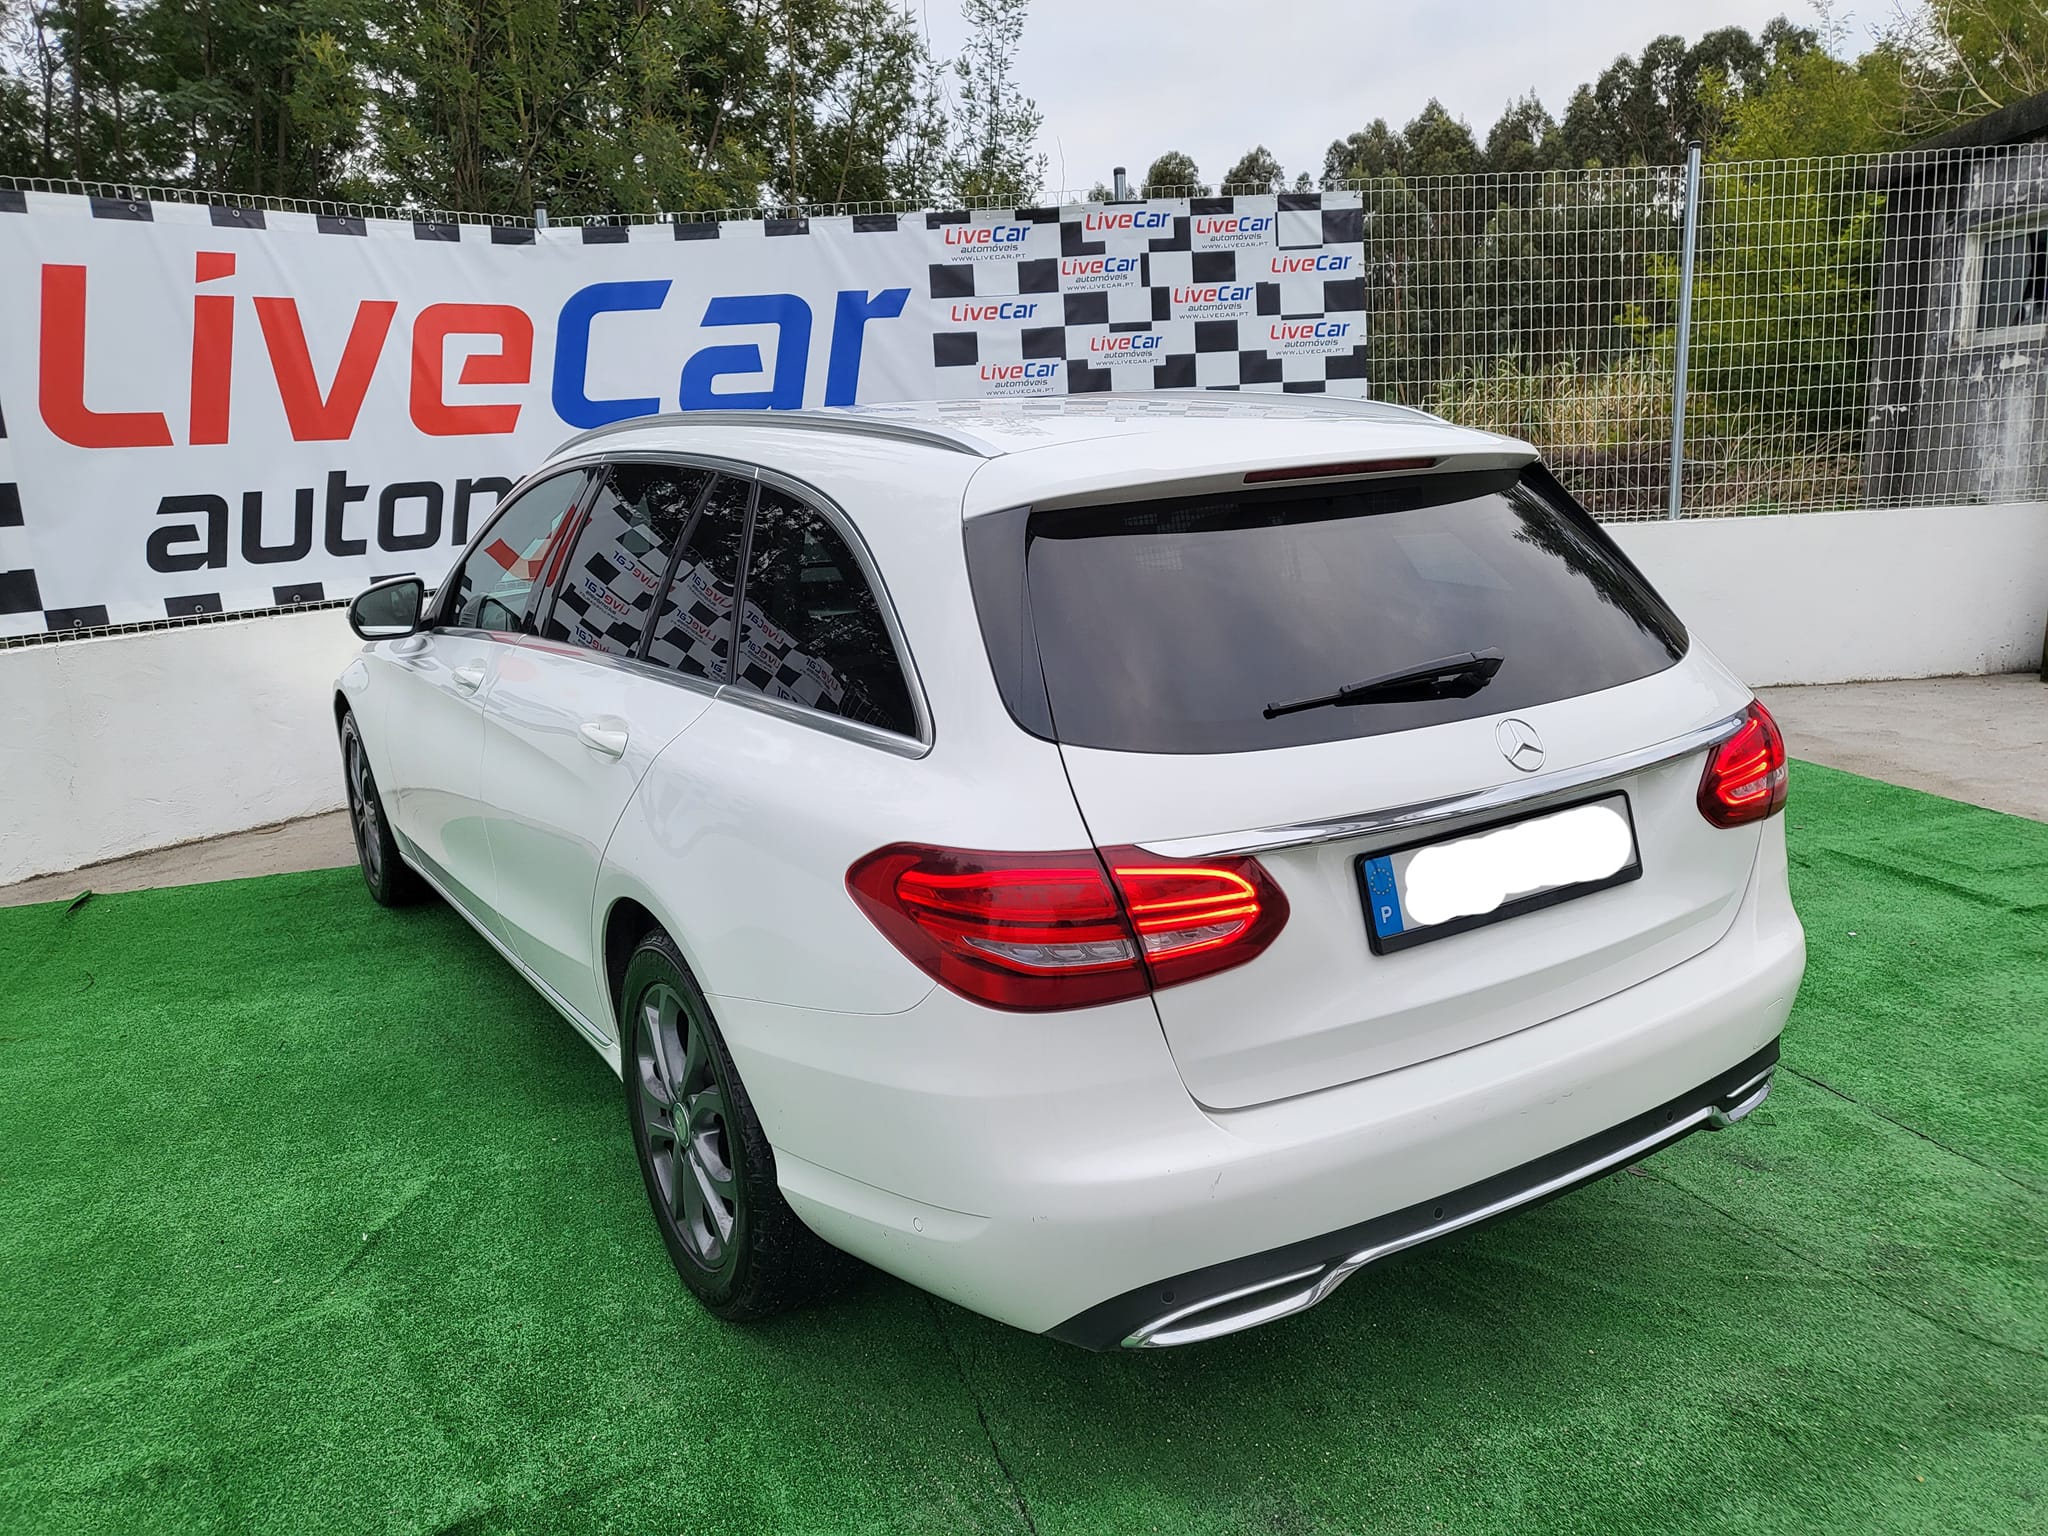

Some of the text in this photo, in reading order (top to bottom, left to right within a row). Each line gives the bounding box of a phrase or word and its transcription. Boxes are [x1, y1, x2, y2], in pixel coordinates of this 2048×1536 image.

[1085, 210, 1170, 231] LiveCar
[1197, 216, 1272, 234] LiveCar
[945, 226, 1030, 245] LiveCar
[1210, 232, 1262, 242] automóveis
[951, 253, 1026, 262] WWW.LIVECAR.PT
[960, 243, 1018, 254] automóveis
[1061, 257, 1138, 276] LiveCar
[1271, 255, 1352, 273] LiveCar
[1075, 273, 1128, 284] automóveis
[1174, 285, 1254, 304] LiveCar
[951, 302, 1038, 322] LiveCar
[1187, 302, 1242, 312] automóveis
[1270, 322, 1350, 340] LiveCar
[39, 251, 912, 448] LiveCar
[1091, 335, 1163, 351] LiveCar
[1284, 338, 1338, 349] automóveis
[1104, 348, 1153, 359] automóveis
[980, 362, 1059, 381] LiveCar
[994, 378, 1048, 389] automóveis
[1381, 905, 1393, 924] P
